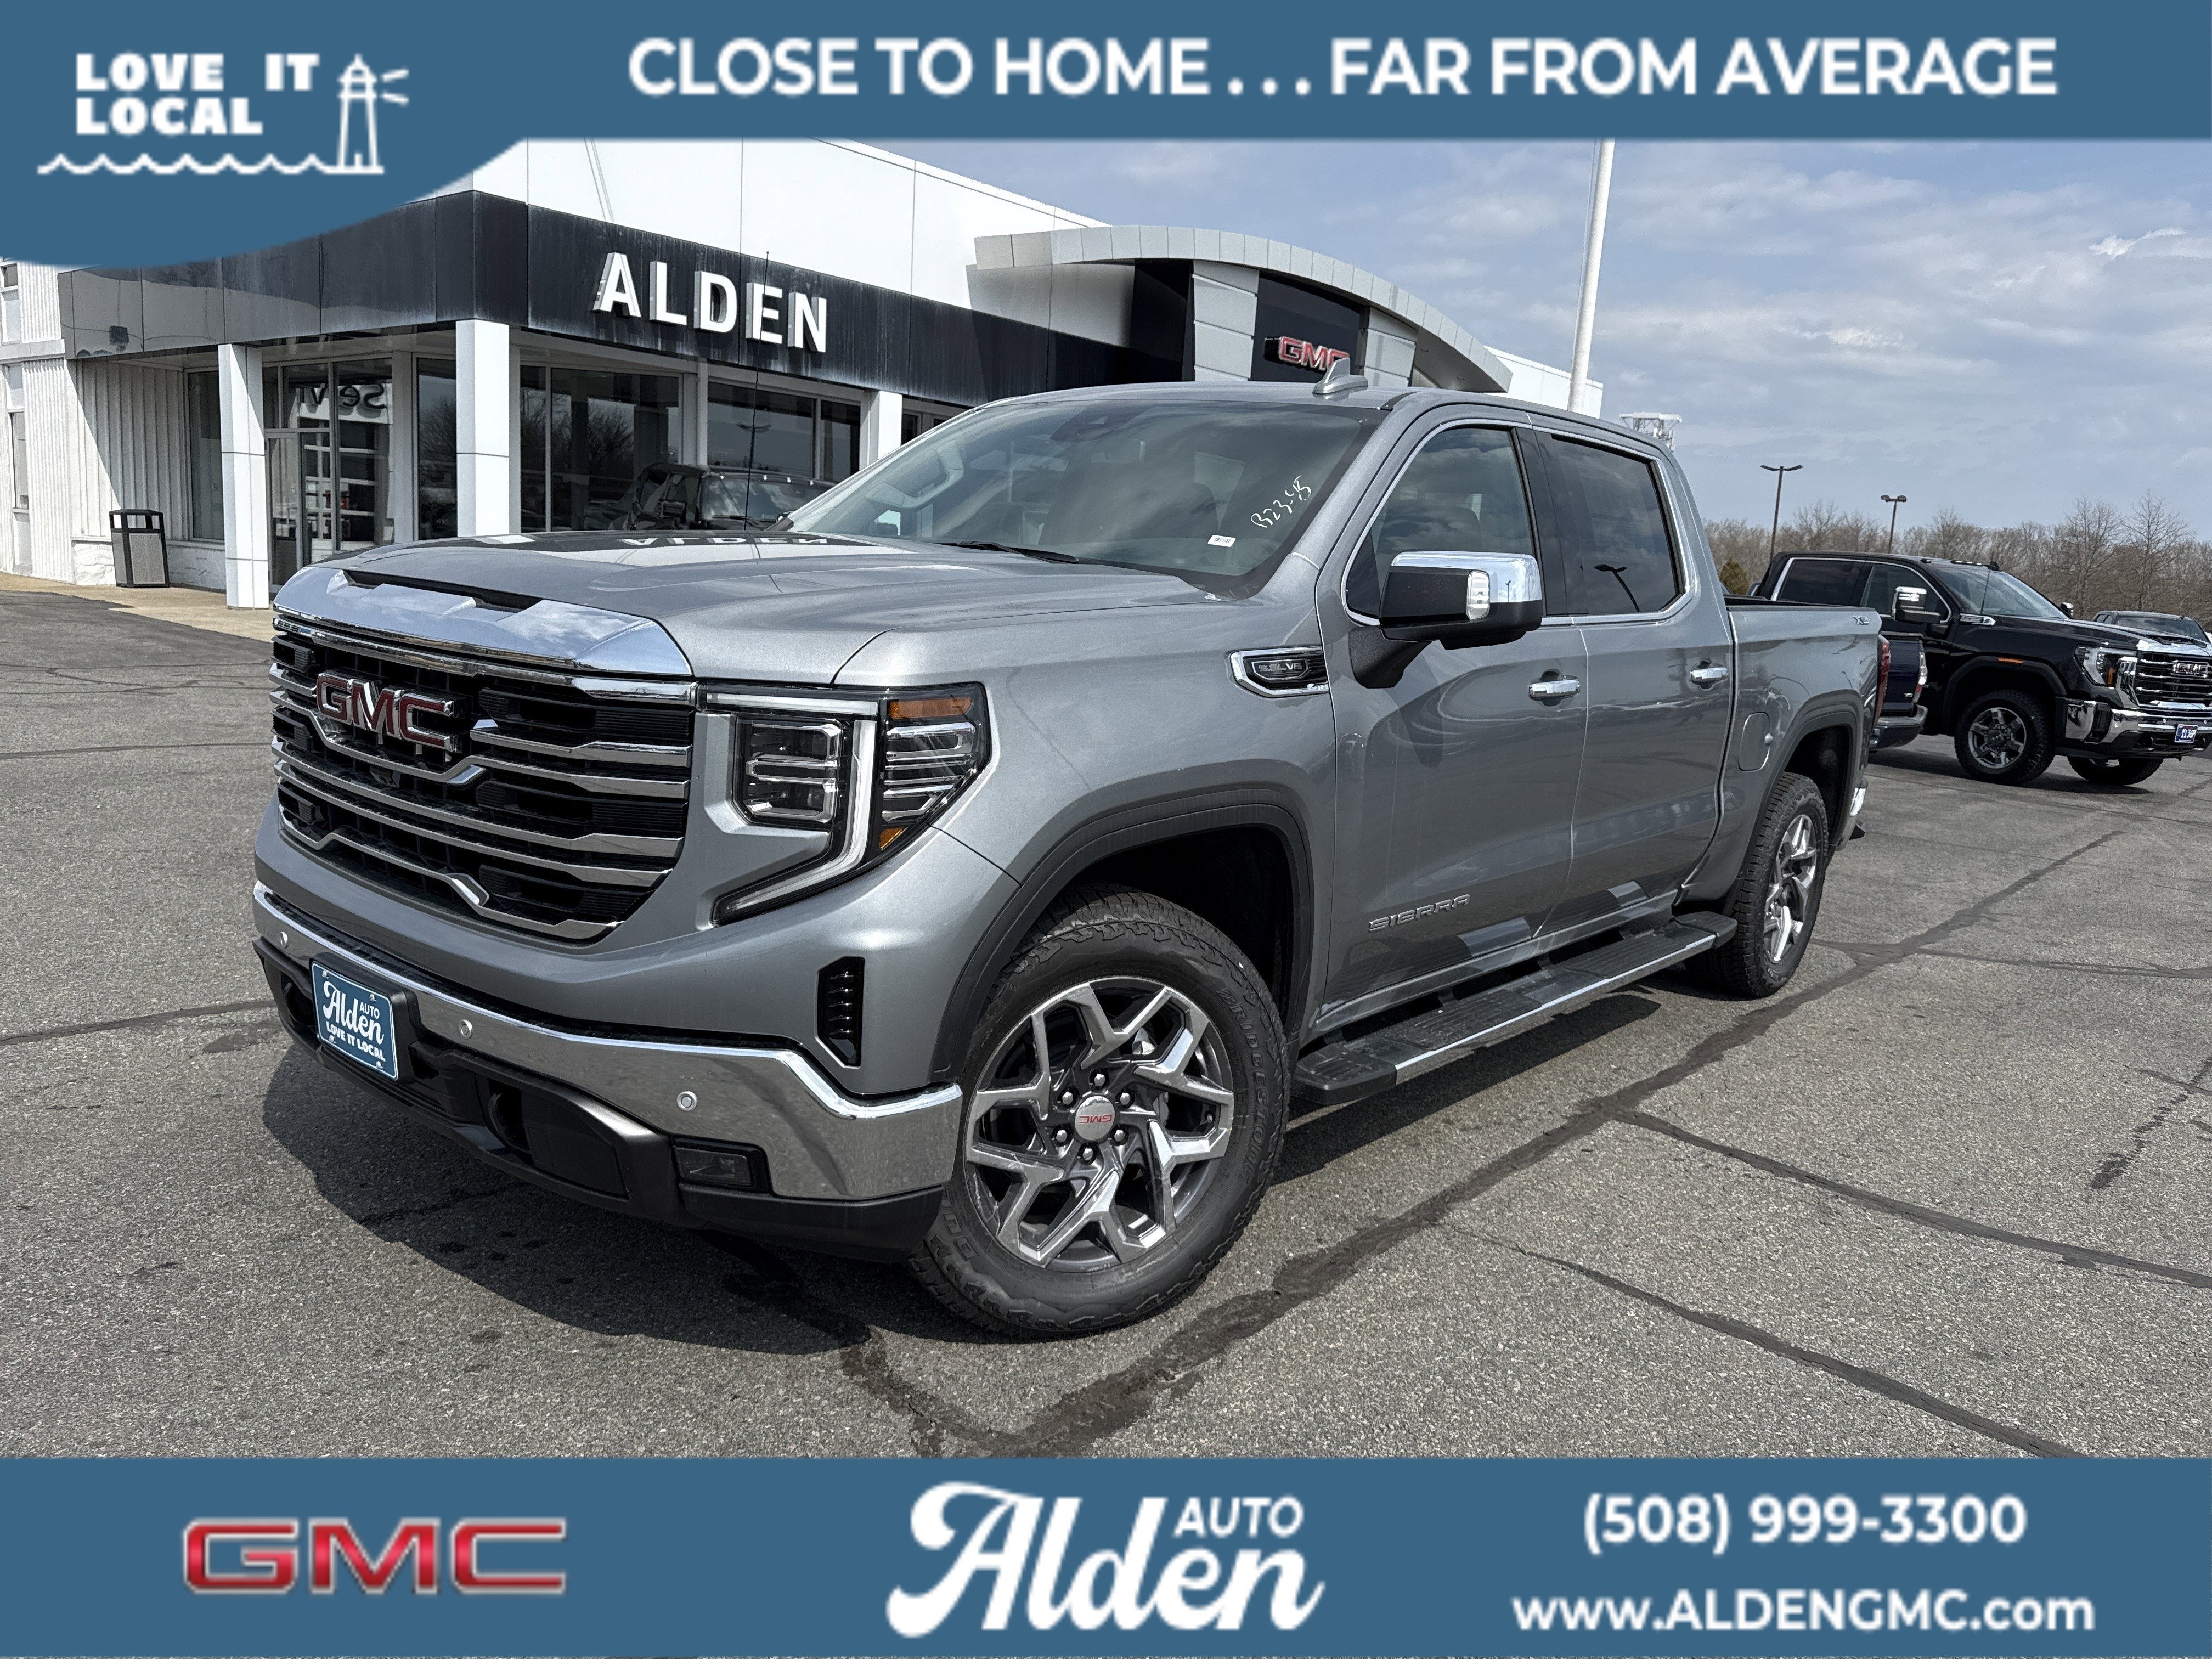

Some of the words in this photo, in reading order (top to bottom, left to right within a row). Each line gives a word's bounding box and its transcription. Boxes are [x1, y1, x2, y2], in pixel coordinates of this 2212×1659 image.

[594, 252, 827, 353] ALDEN
[2176, 663, 2208, 675] GMC
[317, 670, 455, 752] GMC
[1368, 894, 1470, 932] SIERRA
[323, 980, 385, 1045] Alden
[359, 1002, 380, 1019] AUTO
[326, 1021, 346, 1042] LOVE
[347, 1032, 356, 1047] IT
[357, 1038, 386, 1062] LOCAL
[1215, 988, 1268, 1184] BRIDGESTONE
[1078, 1113, 1113, 1124] GMC
